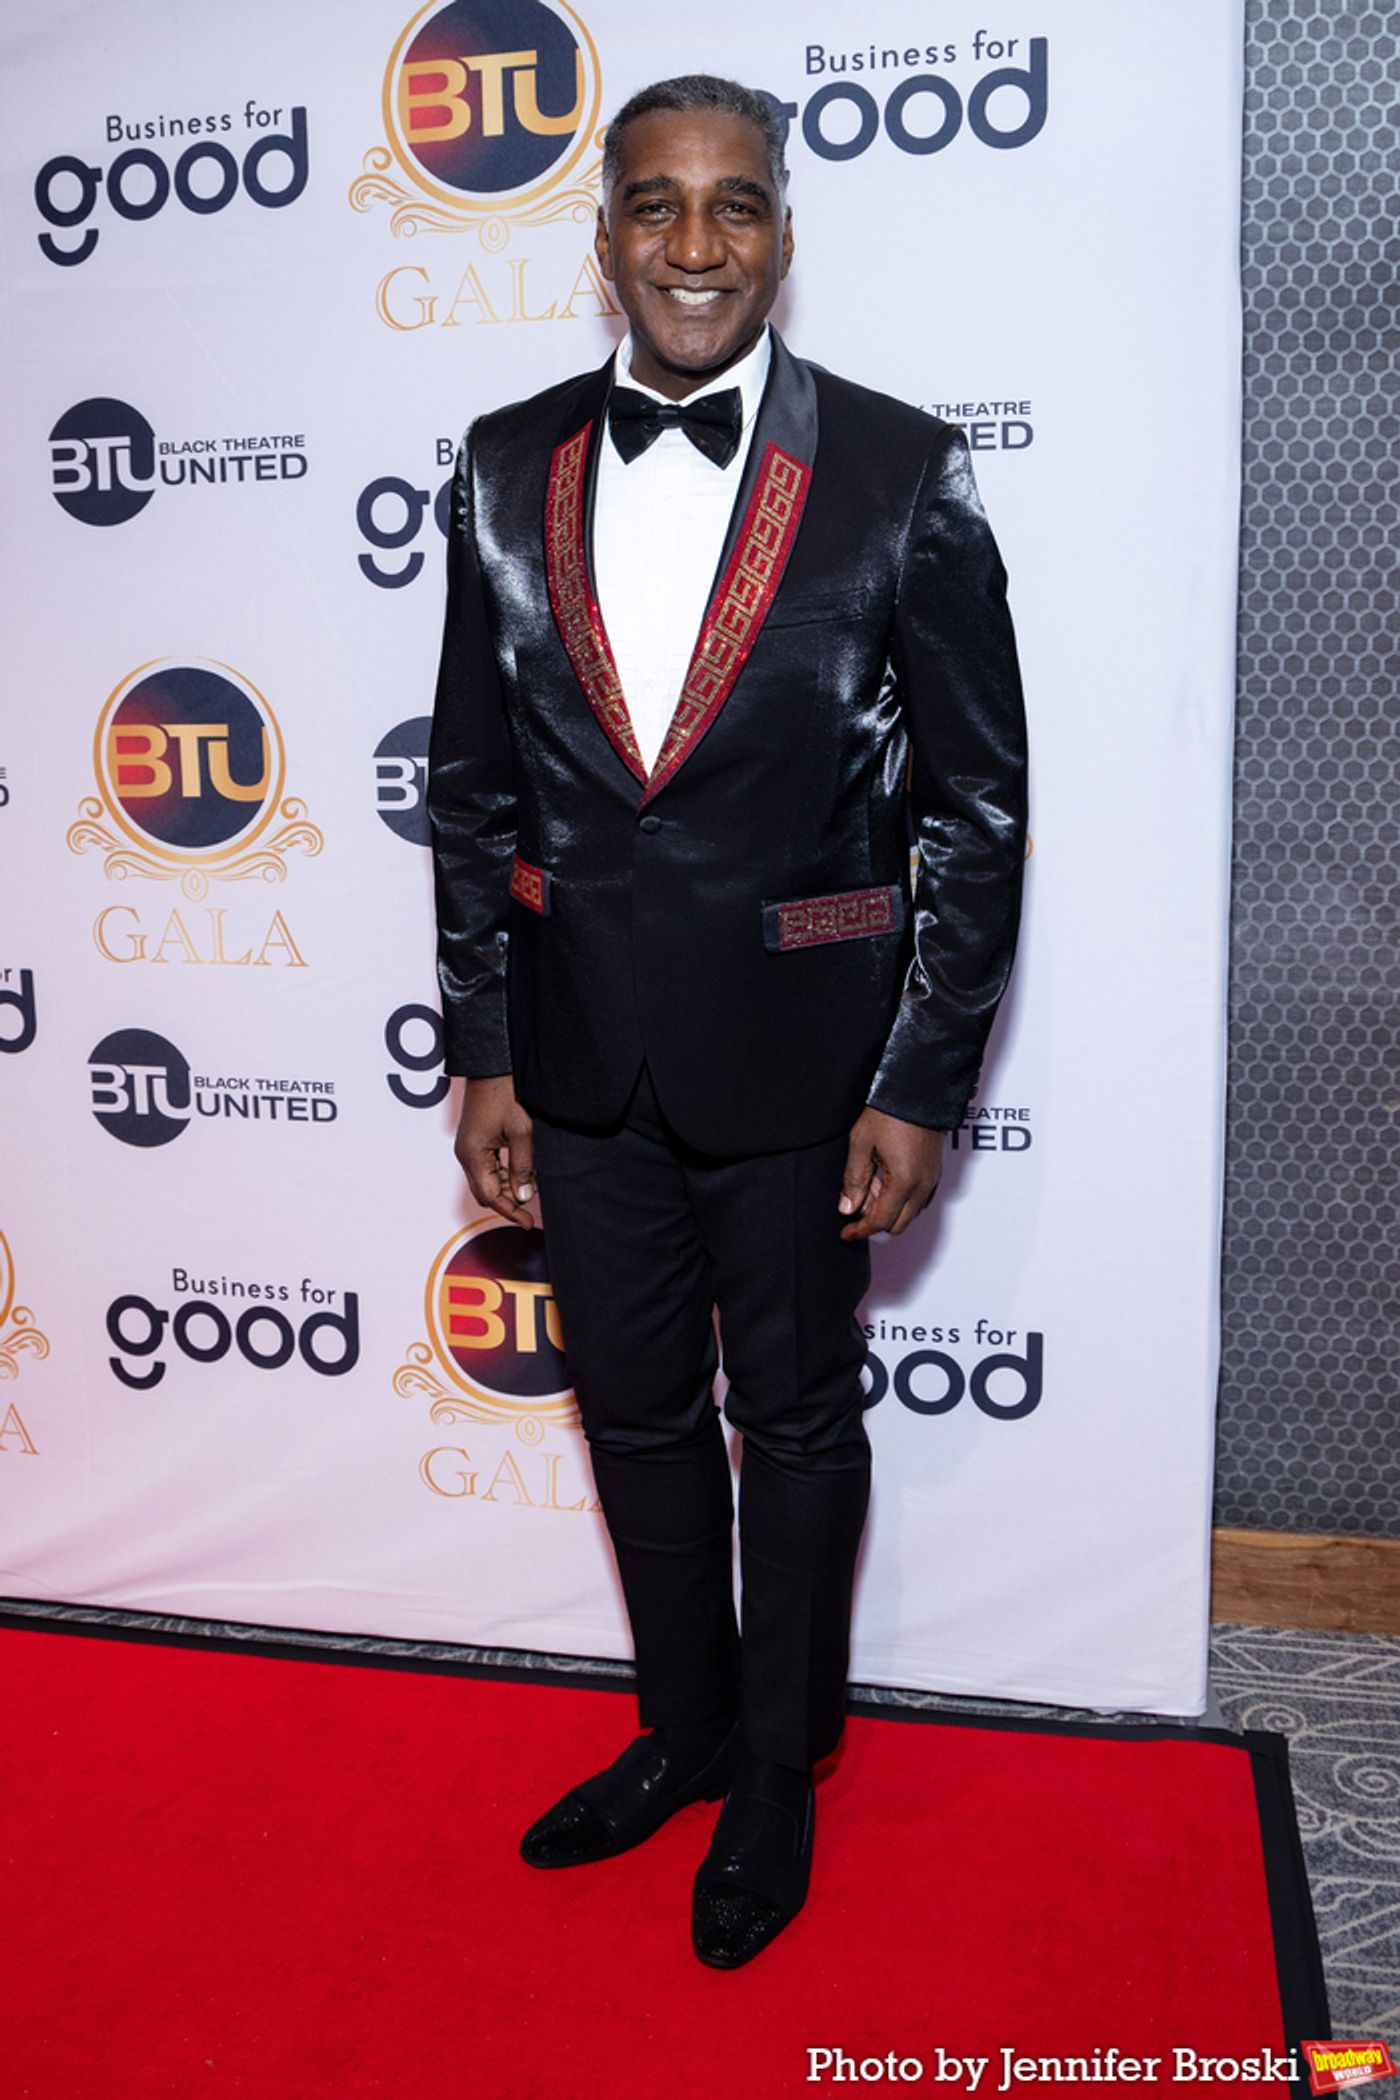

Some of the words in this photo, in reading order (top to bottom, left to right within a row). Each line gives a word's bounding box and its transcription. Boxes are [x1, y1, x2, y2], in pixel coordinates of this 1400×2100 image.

[806, 44, 957, 75] Business
[972, 29, 1019, 60] for
[106, 114, 233, 143] Business
[244, 100, 283, 129] for
[398, 47, 587, 145] BTU
[751, 37, 1049, 162] ood
[34, 106, 309, 268] good
[375, 253, 622, 331] GALA
[932, 400, 1032, 417] THEATRE
[50, 436, 156, 493] BTU
[159, 440, 217, 455] BLACK
[222, 434, 305, 451] THEATRE
[160, 453, 308, 486] UNITED
[109, 723, 272, 802] BTU
[93, 905, 310, 967] GALA
[88, 1063, 192, 1120] BTU
[194, 1075, 250, 1090] BLACK
[255, 1079, 335, 1094] THEATRE
[195, 1092, 338, 1123] UNITED
[964, 1106, 1031, 1121] EATRE
[172, 1267, 289, 1301] Business
[300, 1278, 336, 1305] for
[105, 1292, 360, 1391] good
[864, 1319, 961, 1344] siness
[974, 1319, 1018, 1346] for
[418, 1446, 604, 1513] GAL
